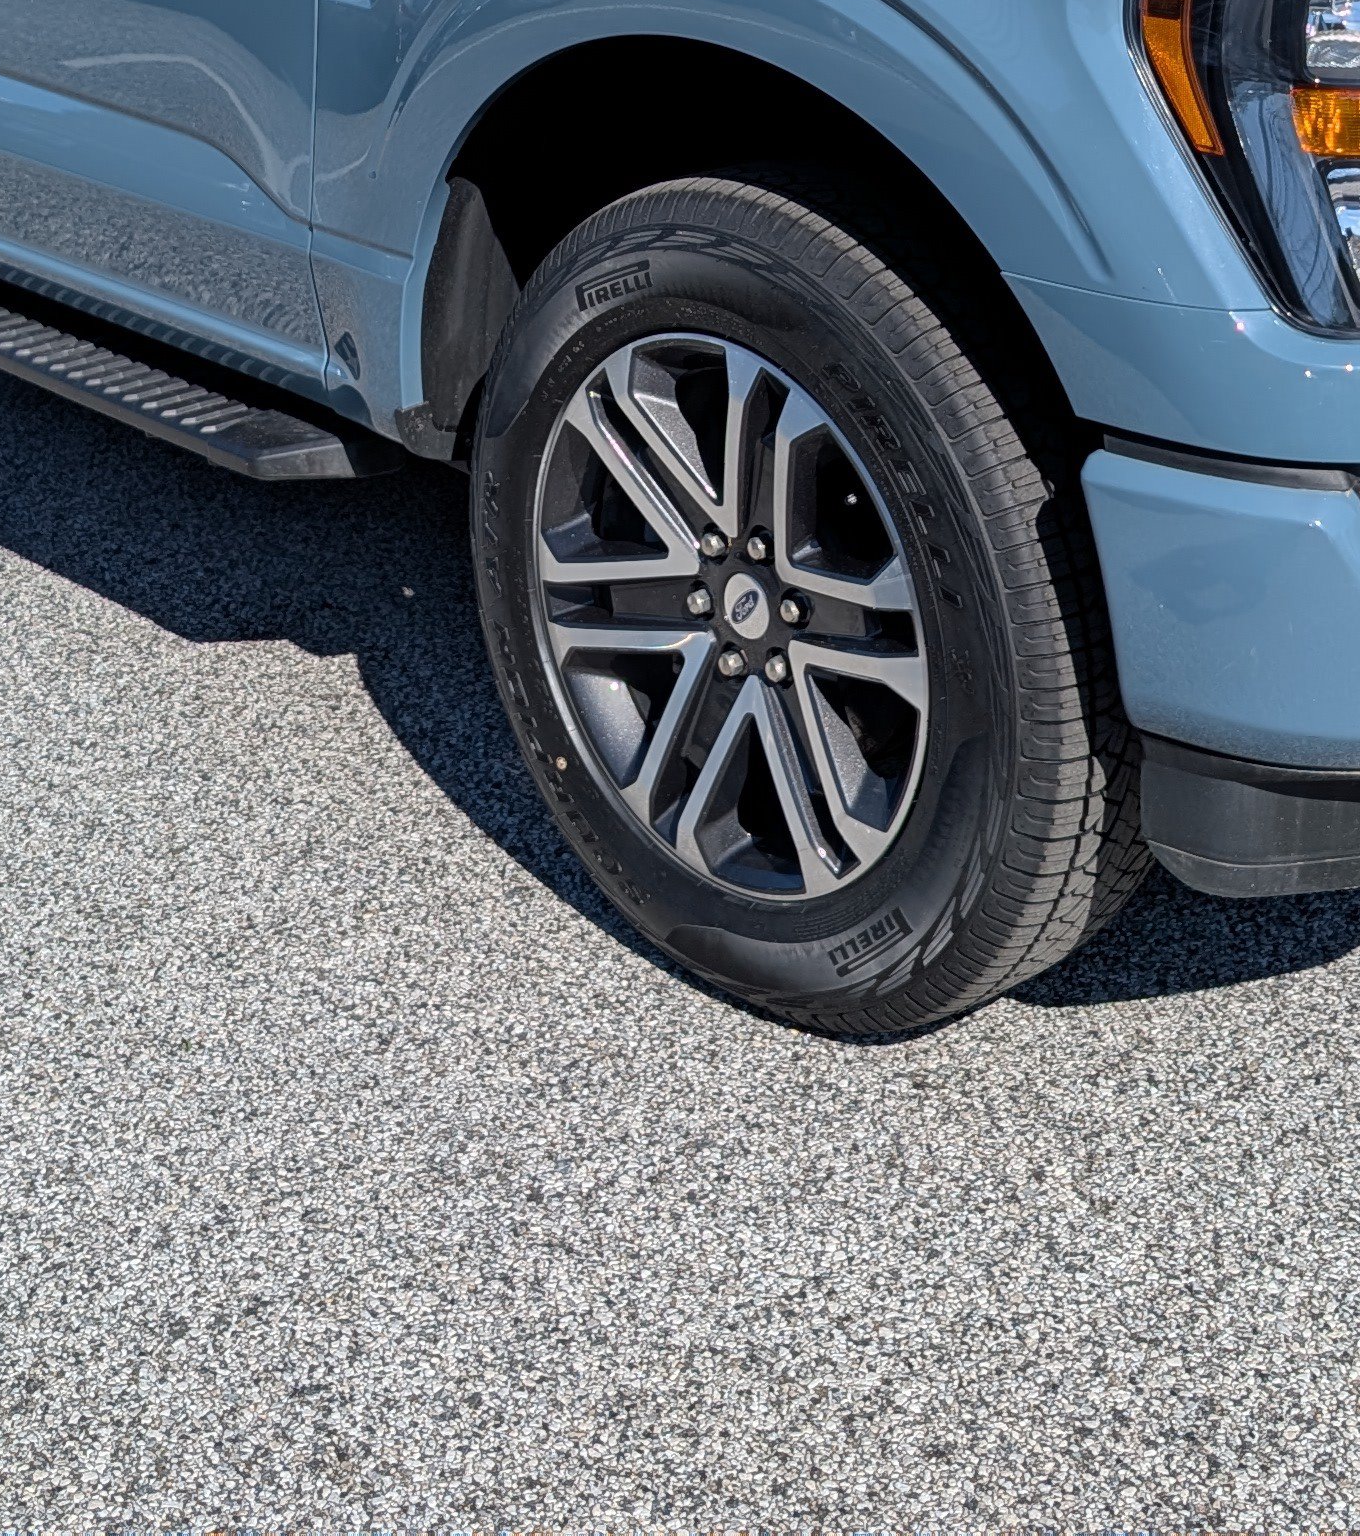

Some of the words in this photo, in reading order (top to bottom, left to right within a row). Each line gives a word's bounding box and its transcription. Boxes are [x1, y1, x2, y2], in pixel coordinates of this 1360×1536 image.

[575, 259, 654, 311] PIRELLI
[824, 361, 965, 611] PIRELLI
[826, 905, 914, 978] PIRELLI
